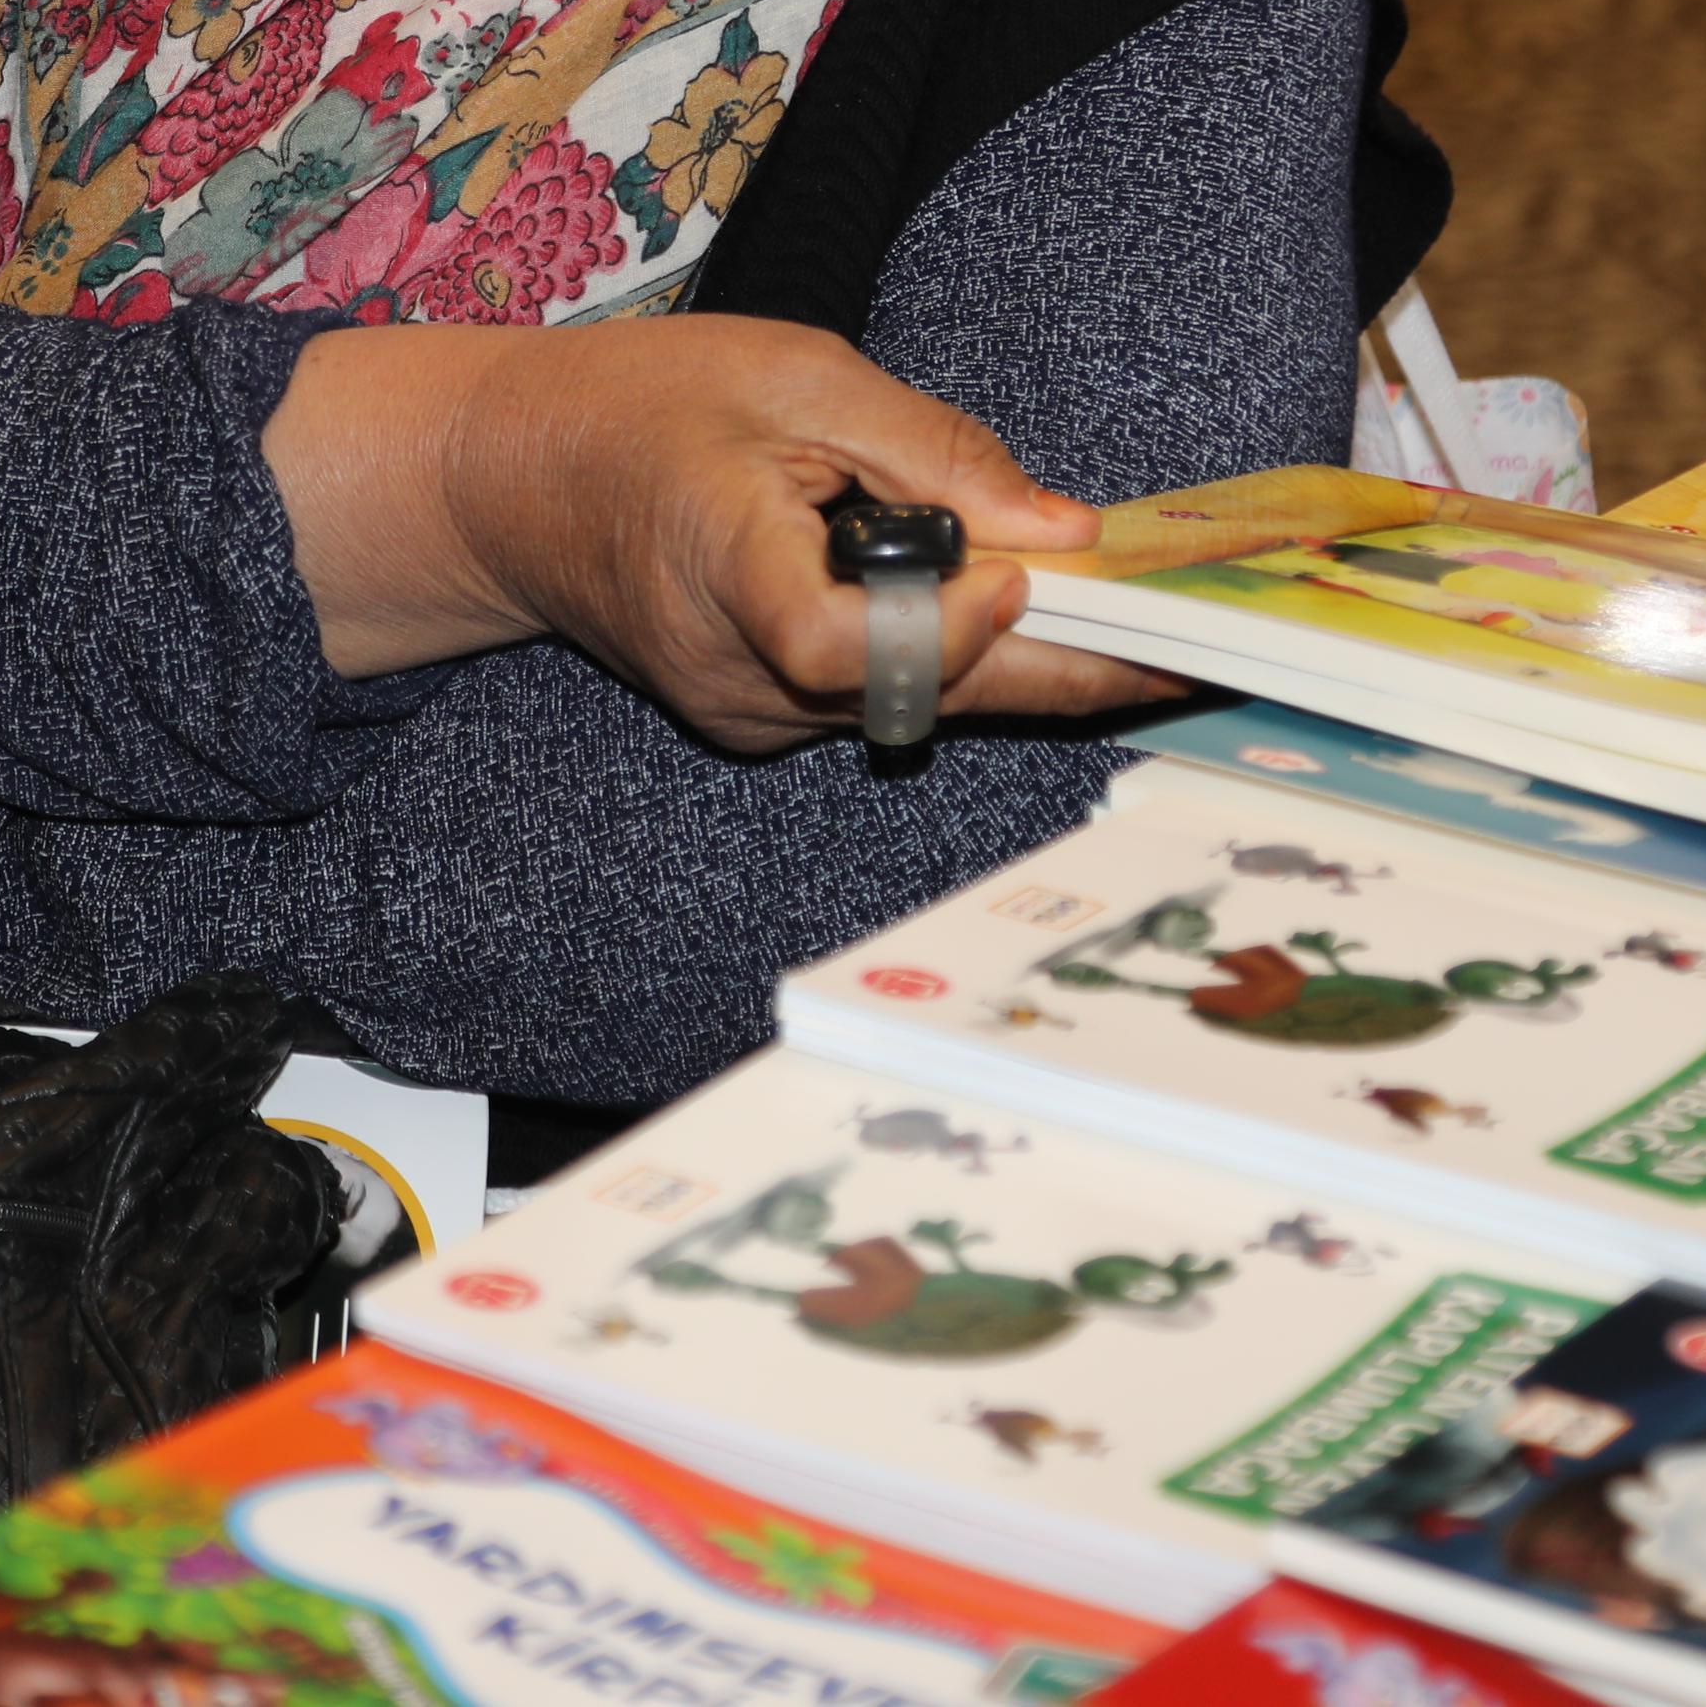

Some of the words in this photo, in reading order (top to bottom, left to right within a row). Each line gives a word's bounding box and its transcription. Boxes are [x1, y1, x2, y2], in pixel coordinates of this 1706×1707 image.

[1201, 1281, 1505, 1499] KAPLUMBAĞA
[371, 1492, 913, 1707] YARDIMSEV
[473, 1611, 738, 1707] KİRP
